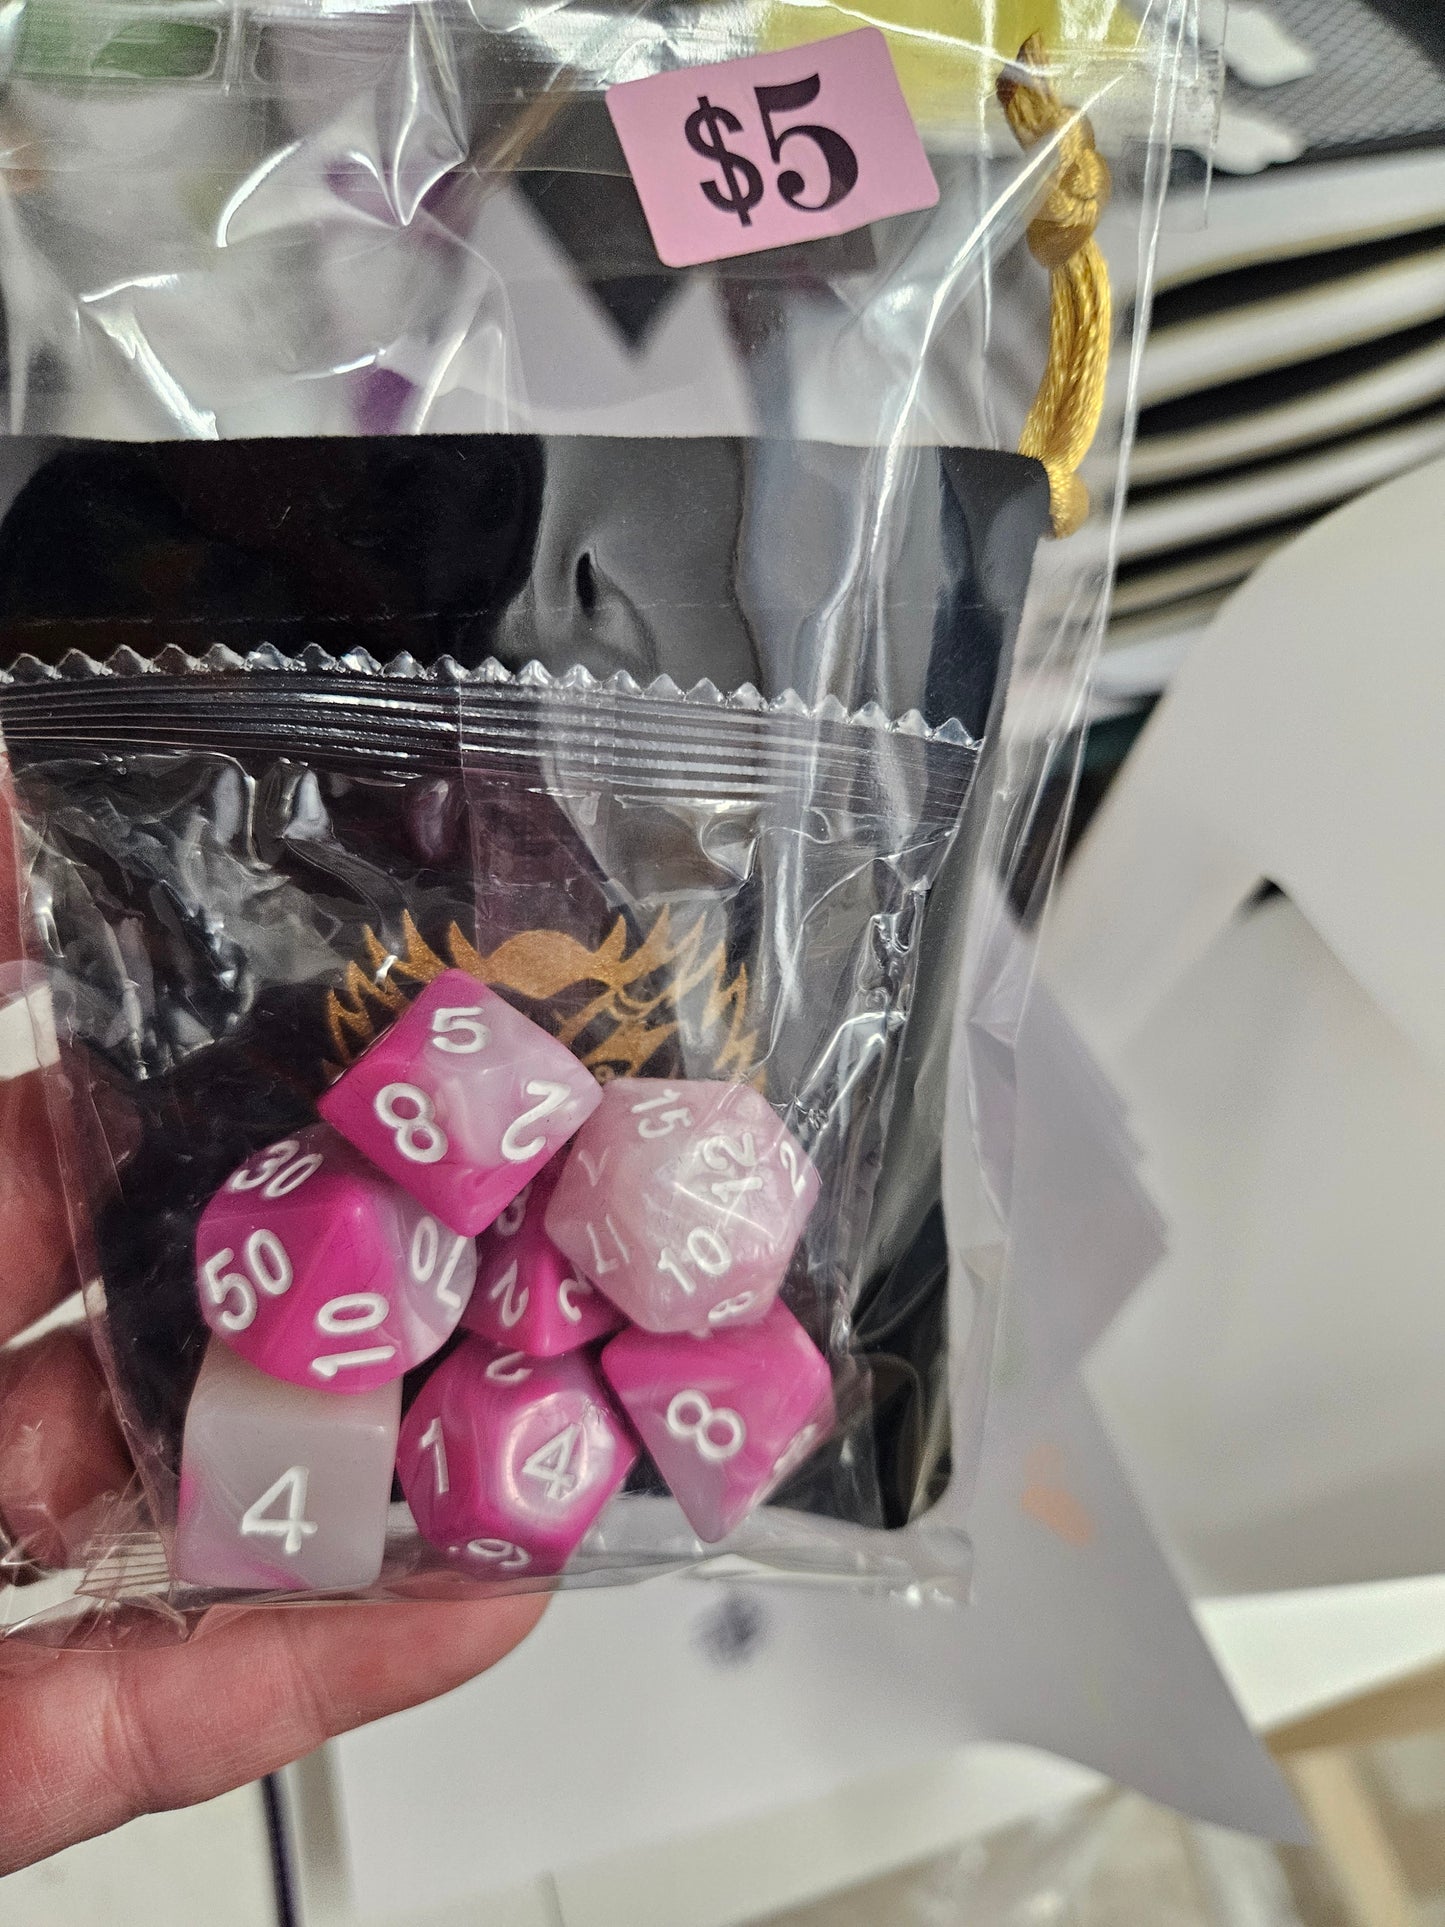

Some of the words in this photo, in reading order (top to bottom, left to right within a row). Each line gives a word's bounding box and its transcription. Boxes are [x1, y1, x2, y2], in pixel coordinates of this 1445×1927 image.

[684, 72, 859, 227] $5
[432, 1007, 492, 1054] 5
[374, 1083, 448, 1163] 8
[632, 1089, 692, 1139] 15
[229, 1140, 324, 1198] 30
[203, 1228, 294, 1331] 50
[658, 1226, 732, 1296] 10
[311, 1292, 396, 1377] 10
[420, 1416, 450, 1495] 1
[522, 1423, 579, 1501] 4
[667, 1389, 746, 1460] 8
[241, 1465, 319, 1554] 4
